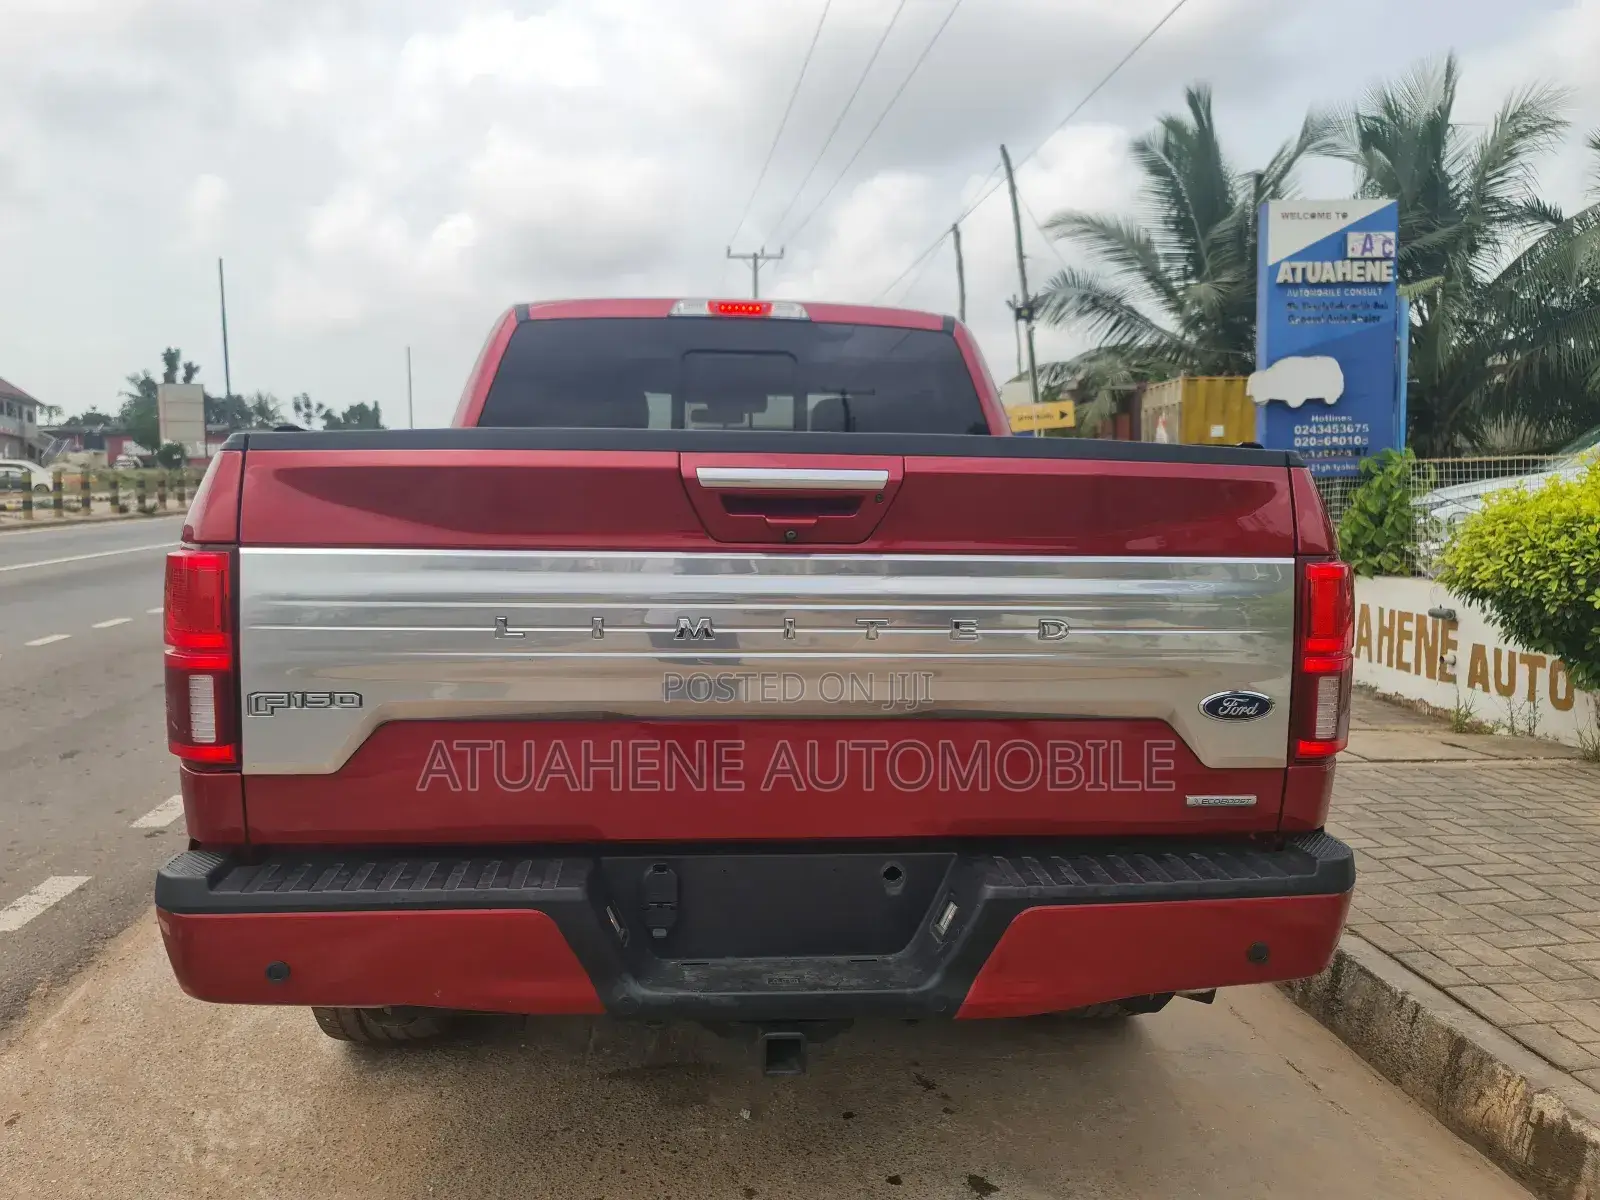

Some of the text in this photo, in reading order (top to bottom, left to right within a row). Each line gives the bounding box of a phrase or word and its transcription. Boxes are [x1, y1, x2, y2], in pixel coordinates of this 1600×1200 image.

[1281, 212, 1348, 220] WELCOME TO
[1276, 260, 1394, 284] ATUAHENE
[1287, 287, 1383, 298] AUTOMOBILE CONSULT
[495, 616, 1070, 641] LIMITED
[1467, 643, 1575, 711] AUTO
[1218, 697, 1260, 716] Ford
